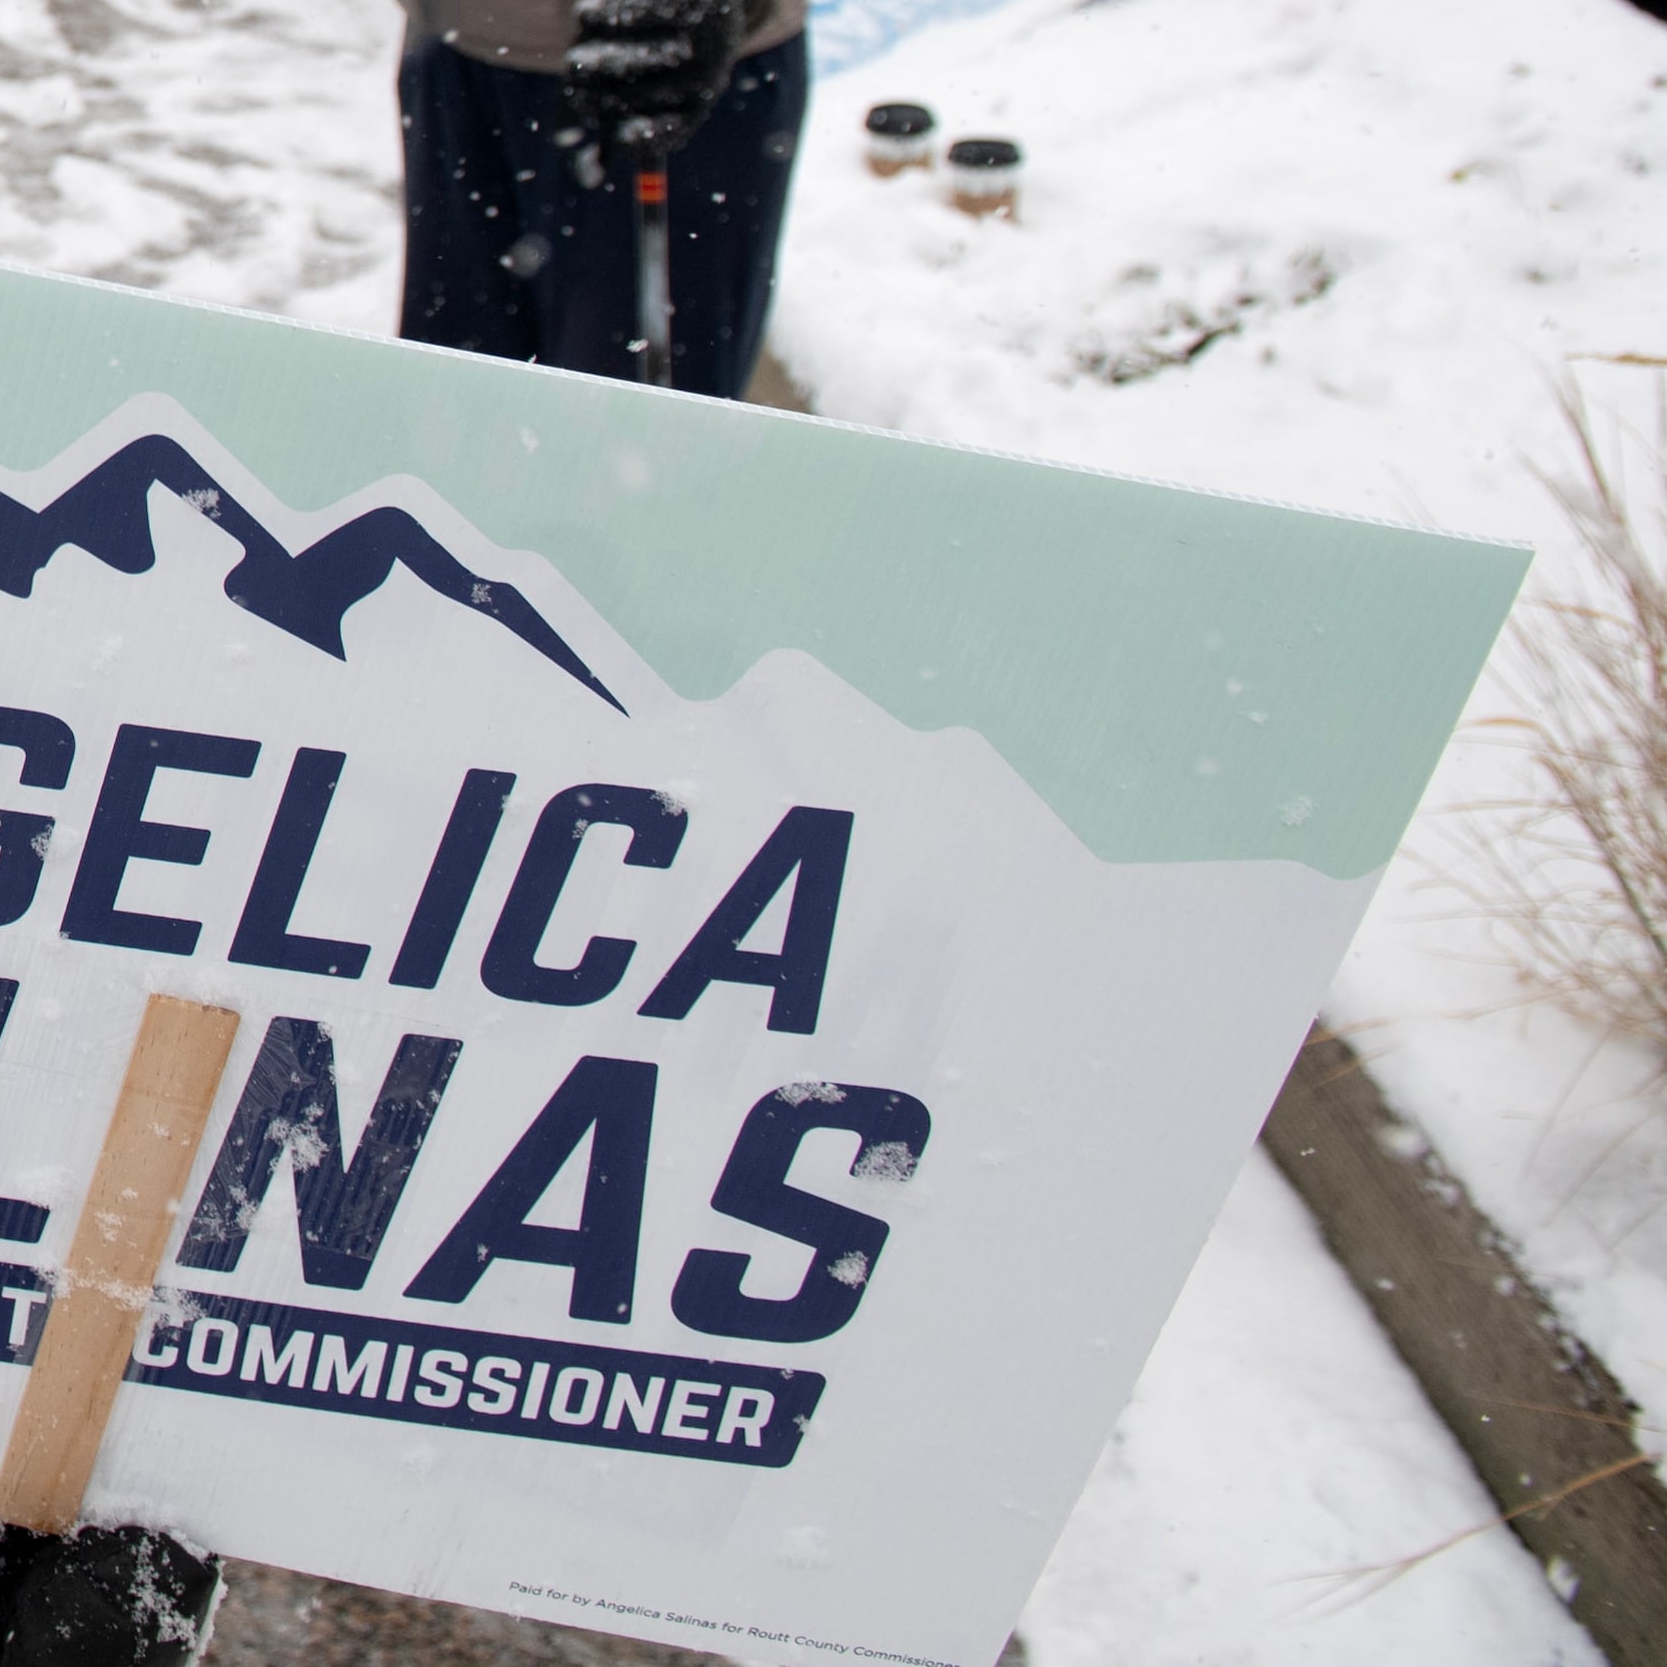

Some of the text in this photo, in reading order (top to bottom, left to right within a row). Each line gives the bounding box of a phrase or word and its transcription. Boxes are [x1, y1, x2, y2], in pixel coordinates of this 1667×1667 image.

[132, 1311, 776, 1447] COMMISSIONER
[509, 1582, 543, 1598] Paid
[547, 1588, 569, 1602] for
[572, 1592, 591, 1608] by
[595, 1598, 661, 1620] Angelica
[665, 1611, 717, 1631] Salinas
[722, 1621, 744, 1635] for
[747, 1626, 791, 1645] Routt
[794, 1635, 849, 1656] County
